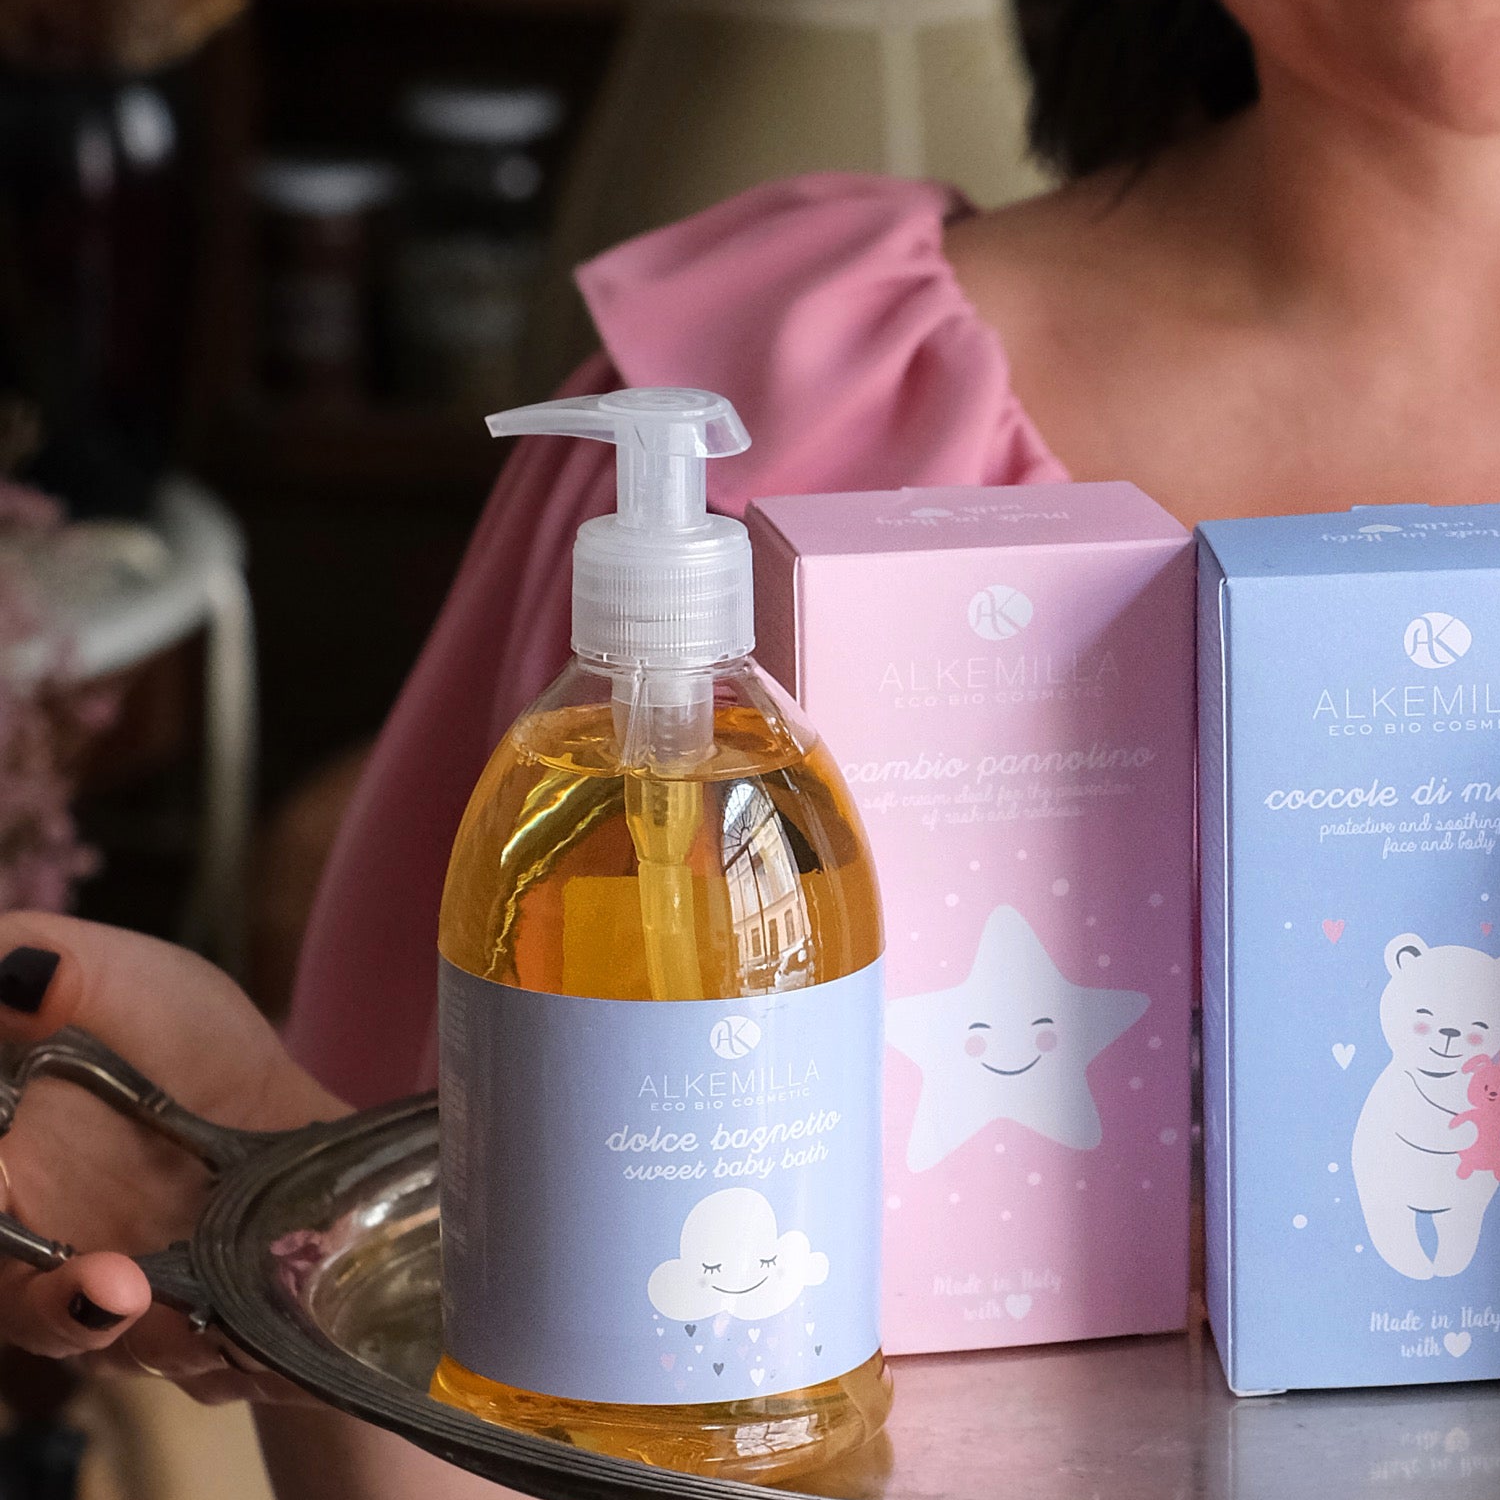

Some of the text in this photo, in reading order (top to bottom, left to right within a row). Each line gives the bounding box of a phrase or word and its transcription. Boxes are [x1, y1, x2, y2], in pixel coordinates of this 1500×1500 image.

[878, 650, 1121, 693] ALKEMILLA
[1329, 724, 1372, 736] ECO
[1386, 722, 1421, 734] BIO
[842, 742, 1156, 784] cambio pannolino
[1264, 778, 1399, 810] coccole
[1411, 777, 1453, 806] di
[1320, 816, 1395, 843] protective
[1399, 813, 1432, 833] and
[1382, 831, 1496, 859] face and body
[638, 1059, 820, 1099] ALKEMILLA
[651, 1087, 811, 1111] ECO BIO COSMETIC
[605, 1109, 841, 1155] dolce bagnetto
[623, 1140, 829, 1181] sweet baby bath
[1370, 1310, 1424, 1332] Made
[1431, 1310, 1453, 1330] in
[1400, 1336, 1441, 1358] with
